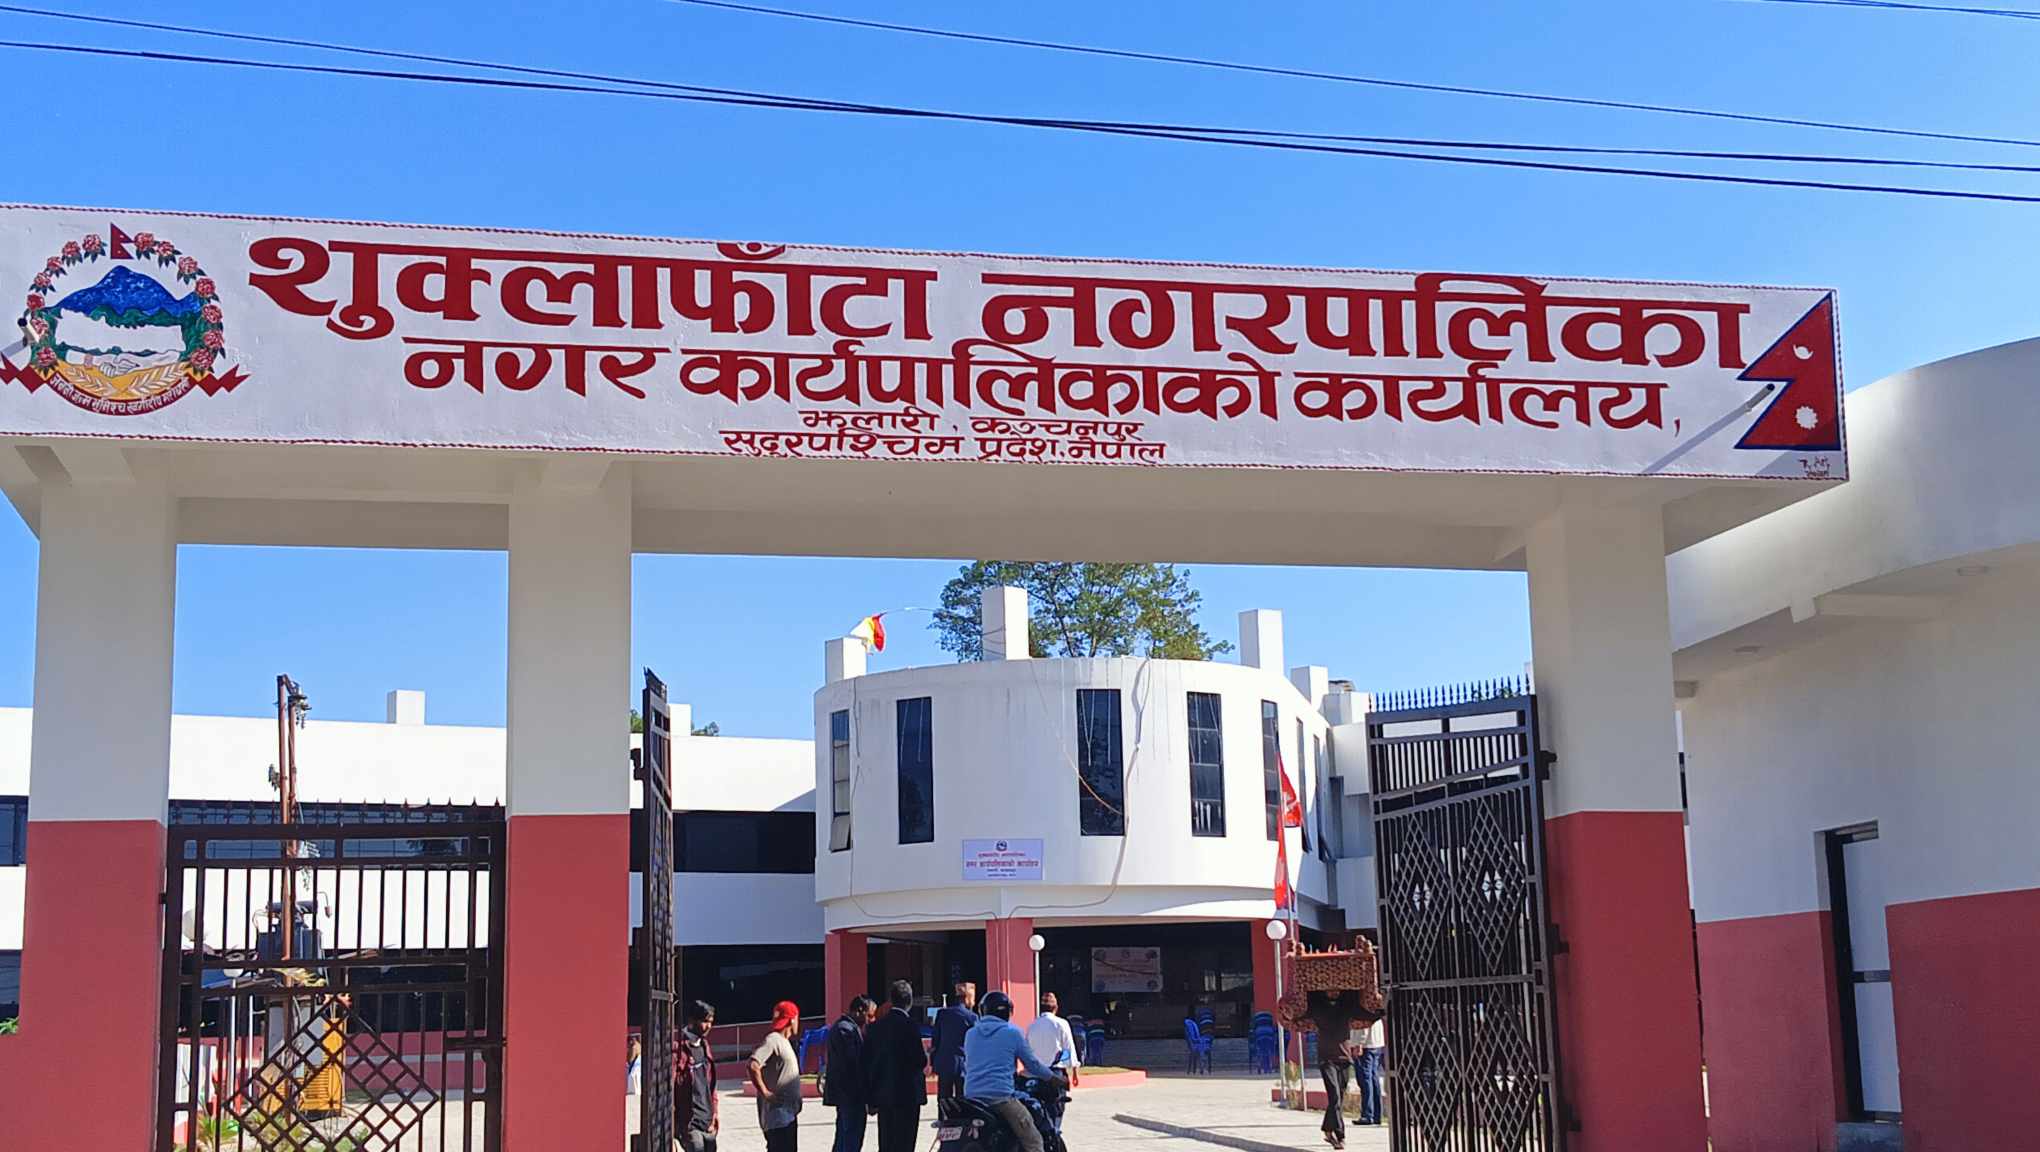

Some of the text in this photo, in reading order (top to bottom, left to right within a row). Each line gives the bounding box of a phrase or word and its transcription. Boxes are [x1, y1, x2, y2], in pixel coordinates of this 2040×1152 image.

[249, 237, 1750, 368] शुक्लाफाँटा नगरपालिका
[404, 336, 1681, 437] नगर कार्यपालिकाको कार्यालय,
